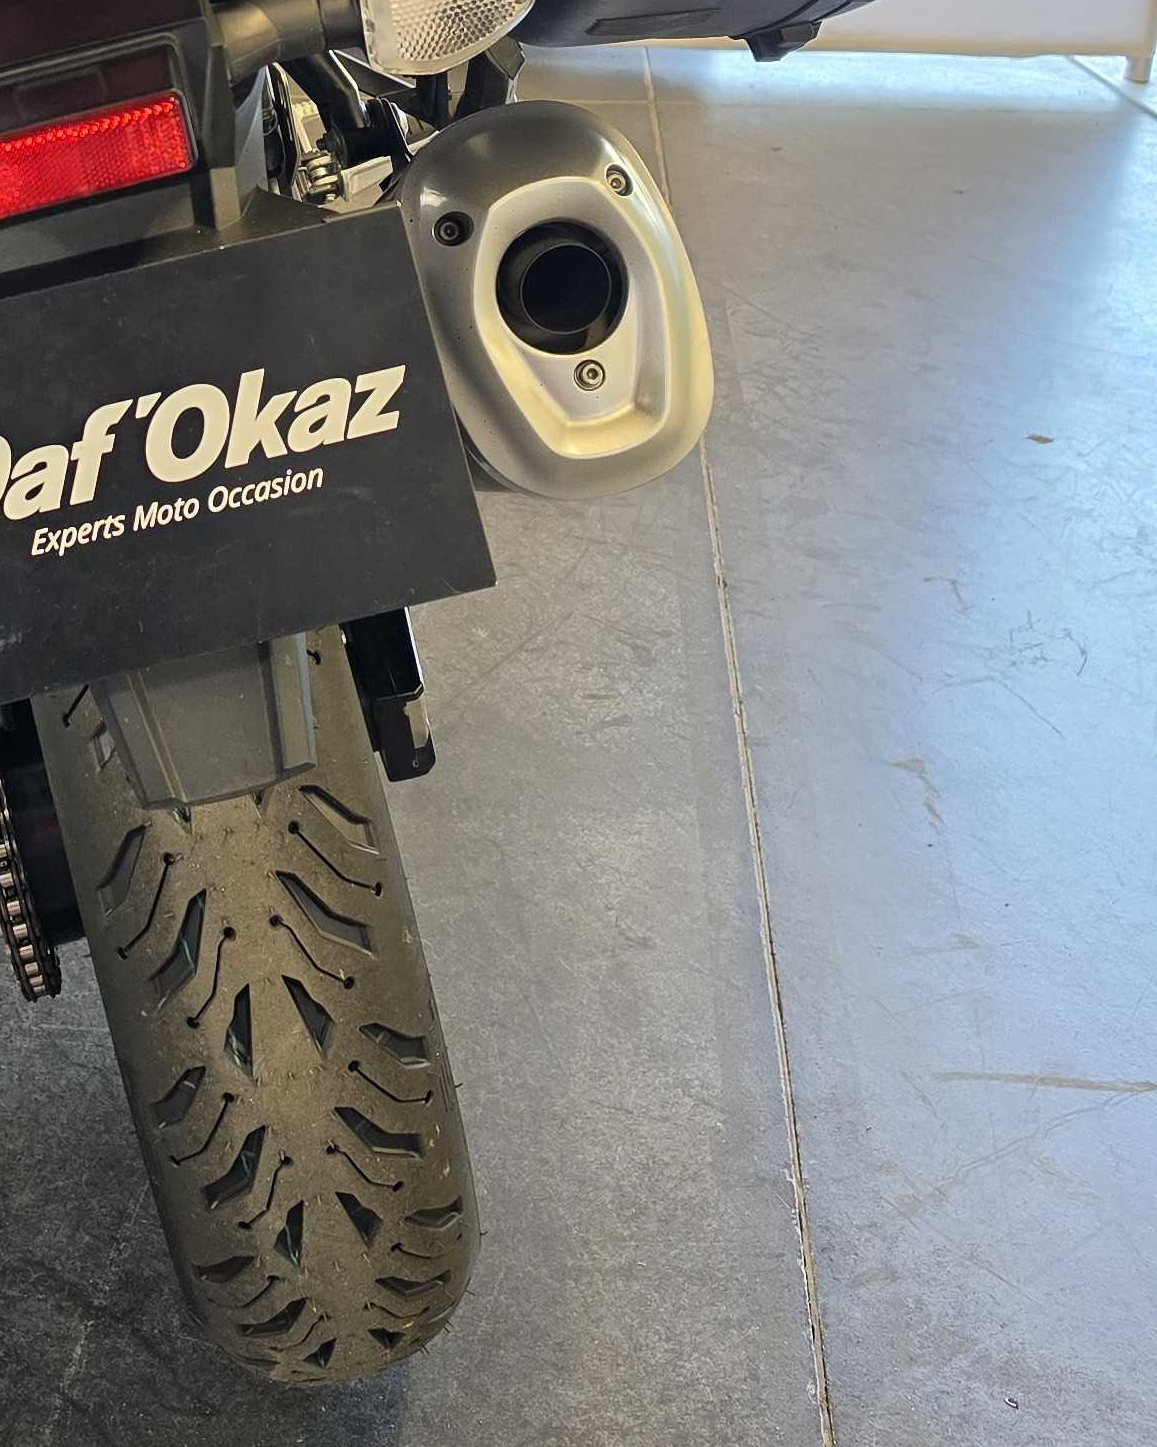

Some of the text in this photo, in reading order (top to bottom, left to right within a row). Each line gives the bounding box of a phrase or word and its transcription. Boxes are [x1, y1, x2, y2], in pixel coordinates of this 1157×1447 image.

[31, 466, 325, 557] Experts Moto Occasion
